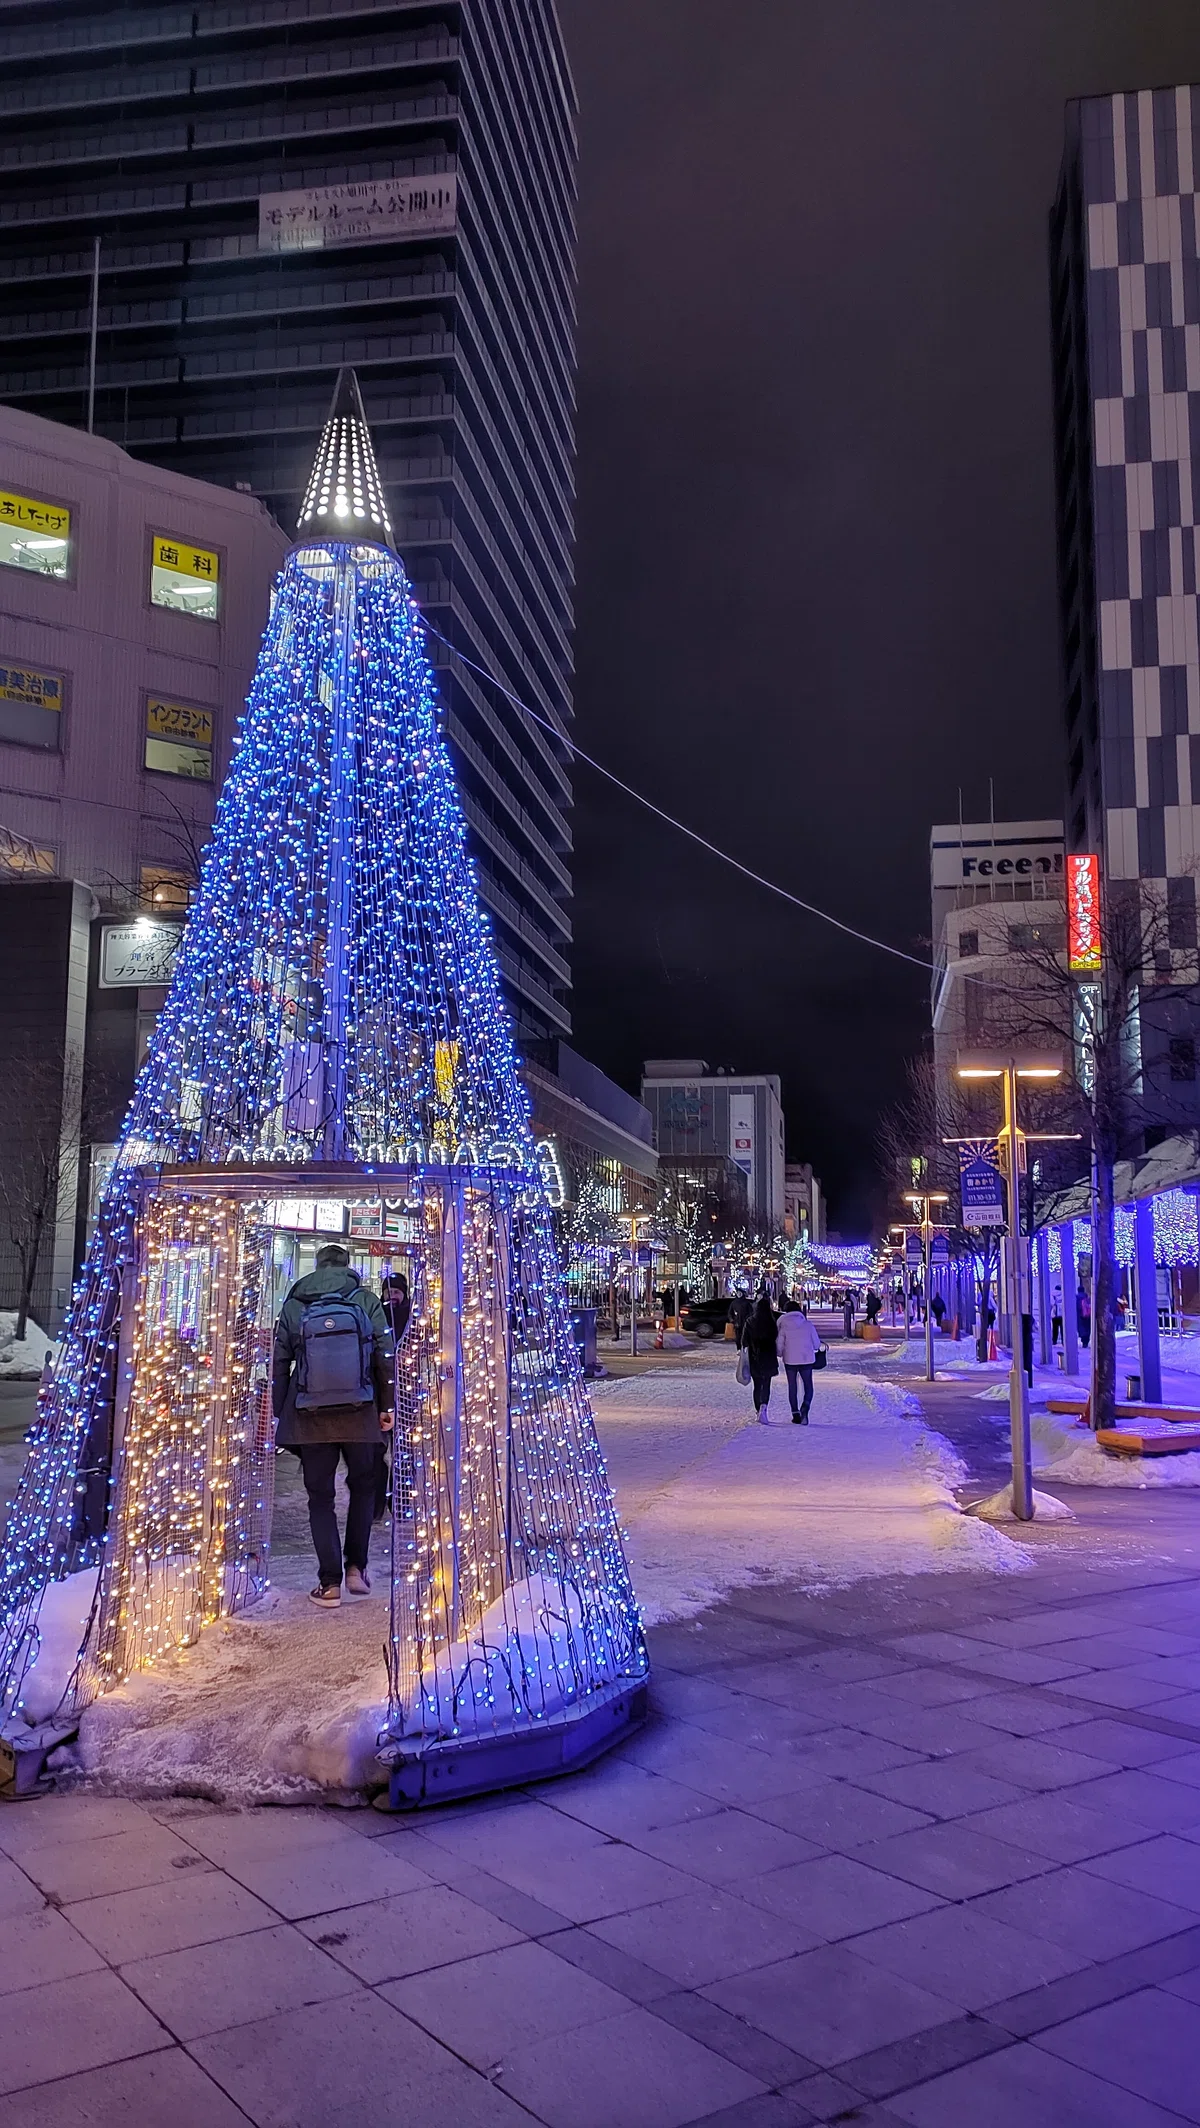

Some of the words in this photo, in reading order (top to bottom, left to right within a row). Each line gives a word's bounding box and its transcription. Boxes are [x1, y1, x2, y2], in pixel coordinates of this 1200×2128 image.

[265, 188, 450, 225] モデルルーム公開中
[0, 501, 67, 530] あしたば
[159, 546, 212, 575] 歯科
[150, 705, 211, 732] インプラント
[355, 1208, 377, 1216] たばこ
[356, 1227, 375, 1235] ATM
